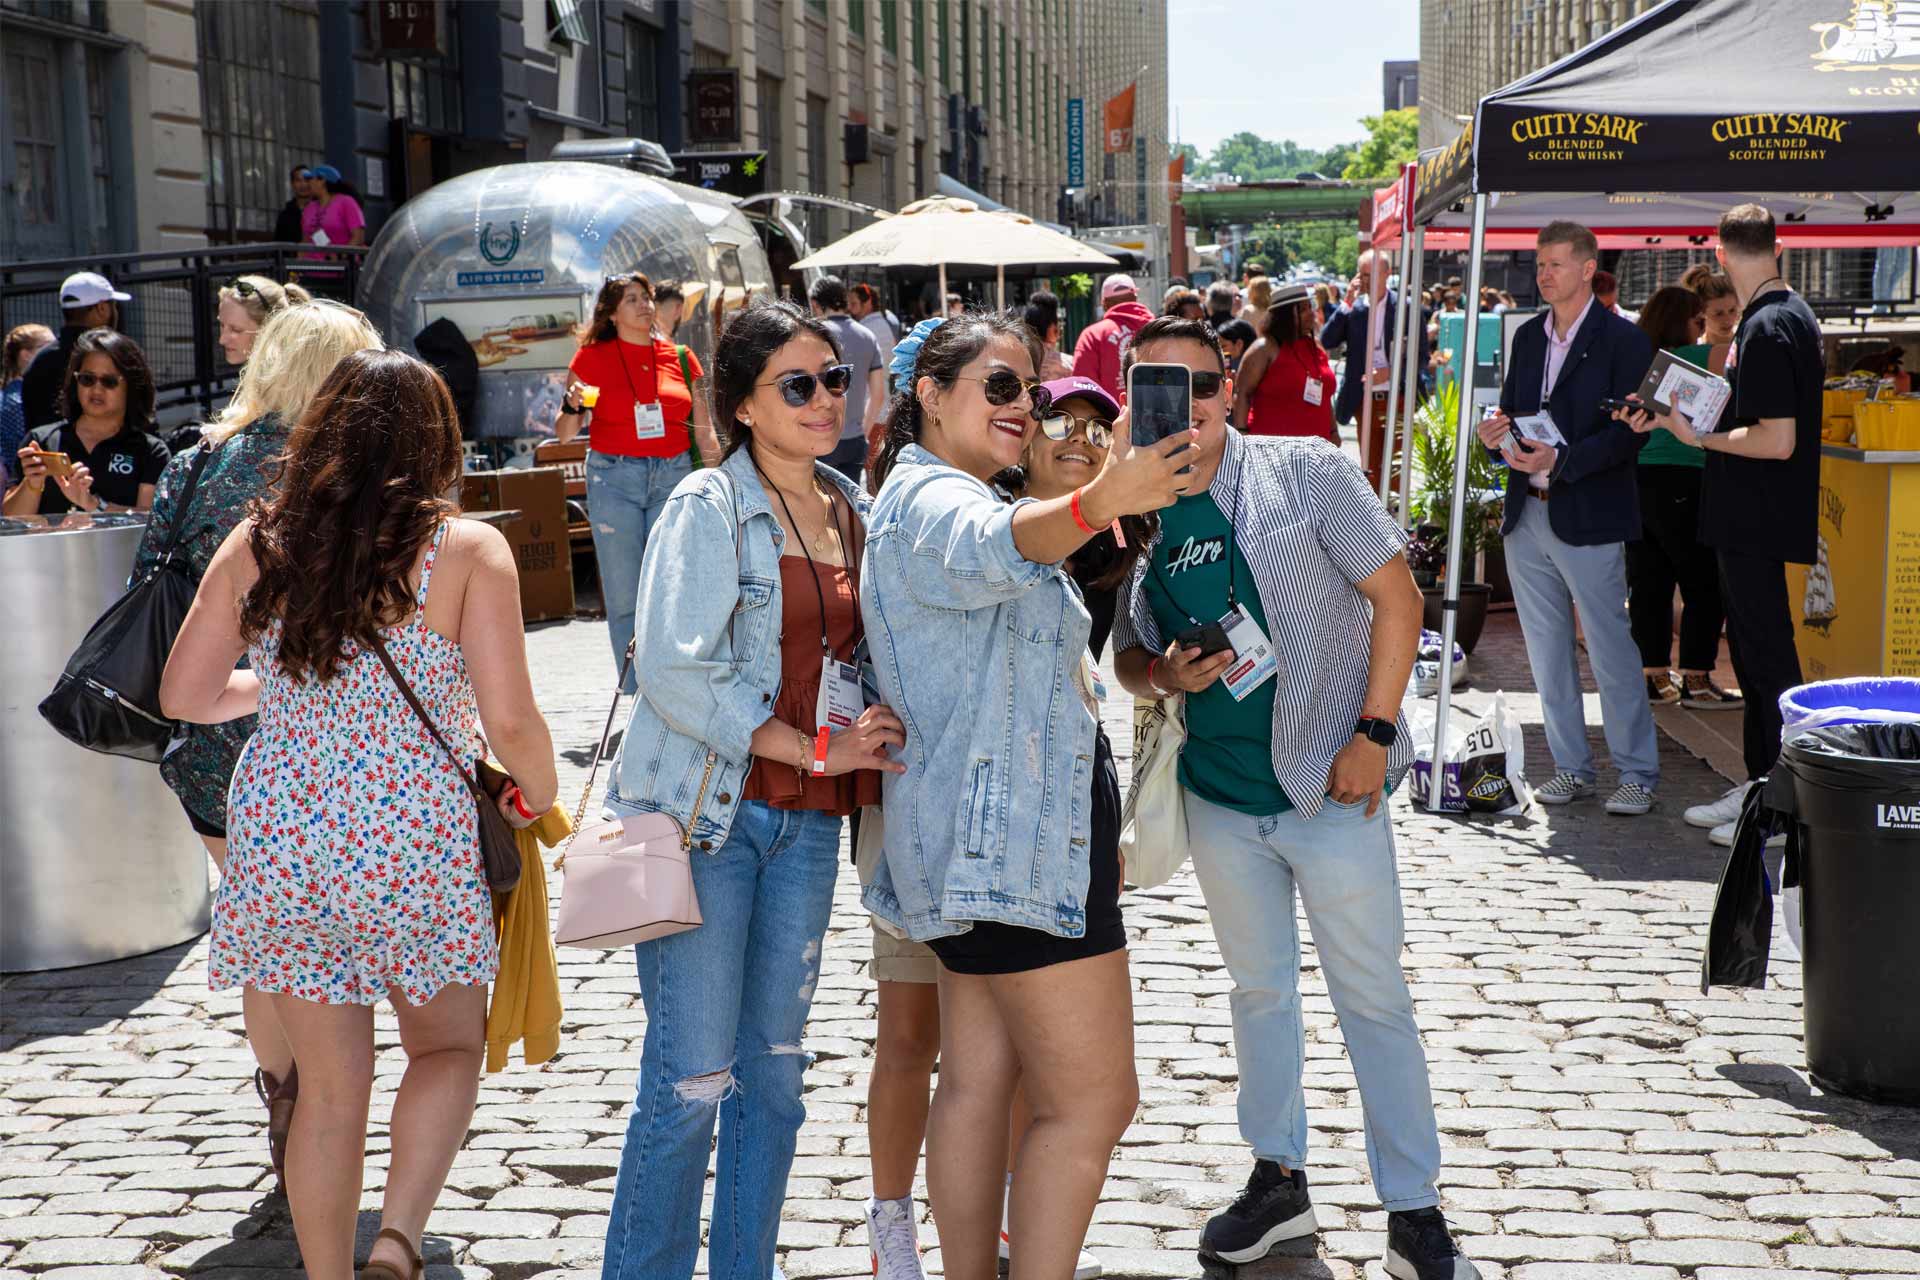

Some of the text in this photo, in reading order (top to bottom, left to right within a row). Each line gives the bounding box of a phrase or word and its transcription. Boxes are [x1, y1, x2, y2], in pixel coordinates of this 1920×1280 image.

[1511, 112, 1644, 145] CUTTY SARK
[1711, 112, 1848, 144] CUTTY SARK
[1070, 103, 1082, 186] INNOVATION
[1548, 139, 1604, 150] BLENDED
[1750, 138, 1807, 149] BLENDED
[1528, 151, 1624, 161] SCOTCH WHISKY
[1728, 150, 1827, 160] SCOTCH WHISKY
[459, 272, 542, 284] AIRSTREAM
[108, 461, 134, 475] KO
[519, 542, 556, 557] HIGH
[1165, 535, 1224, 577] Aero
[520, 558, 556, 571] WEST
[1466, 728, 1494, 753] 0.5
[1408, 767, 1461, 799] SND
[1471, 777, 1510, 797] SAKRETE
[1877, 803, 1920, 828] LAVE
